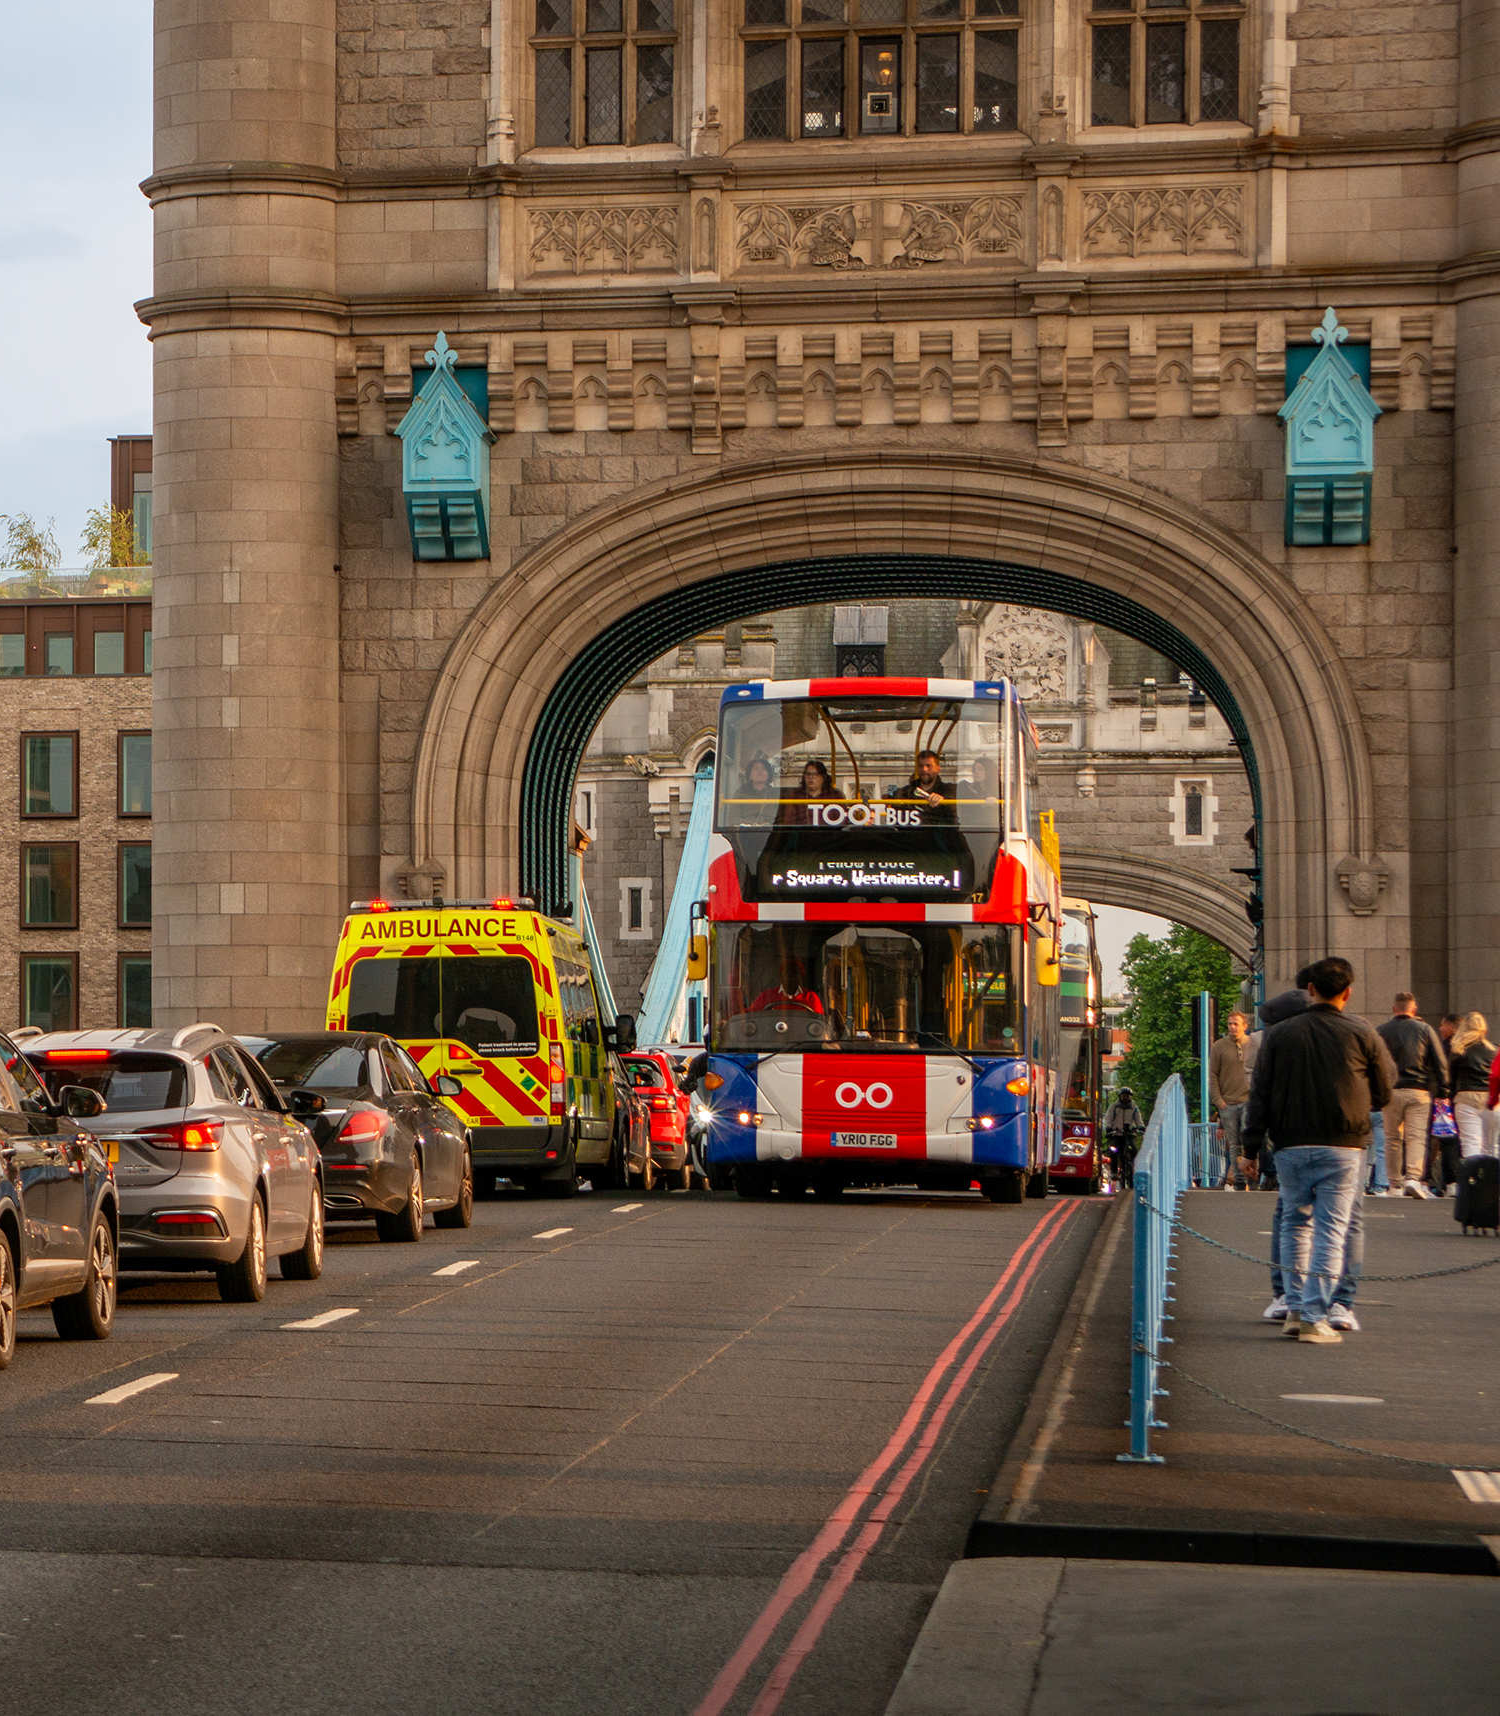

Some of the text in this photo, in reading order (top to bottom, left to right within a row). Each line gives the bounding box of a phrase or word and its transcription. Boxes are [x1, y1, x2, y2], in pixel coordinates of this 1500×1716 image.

[786, 870, 848, 887] Square,
[852, 870, 950, 887] Westminster,
[971, 893, 984, 903] 17
[361, 919, 517, 940] AMBULANCE
